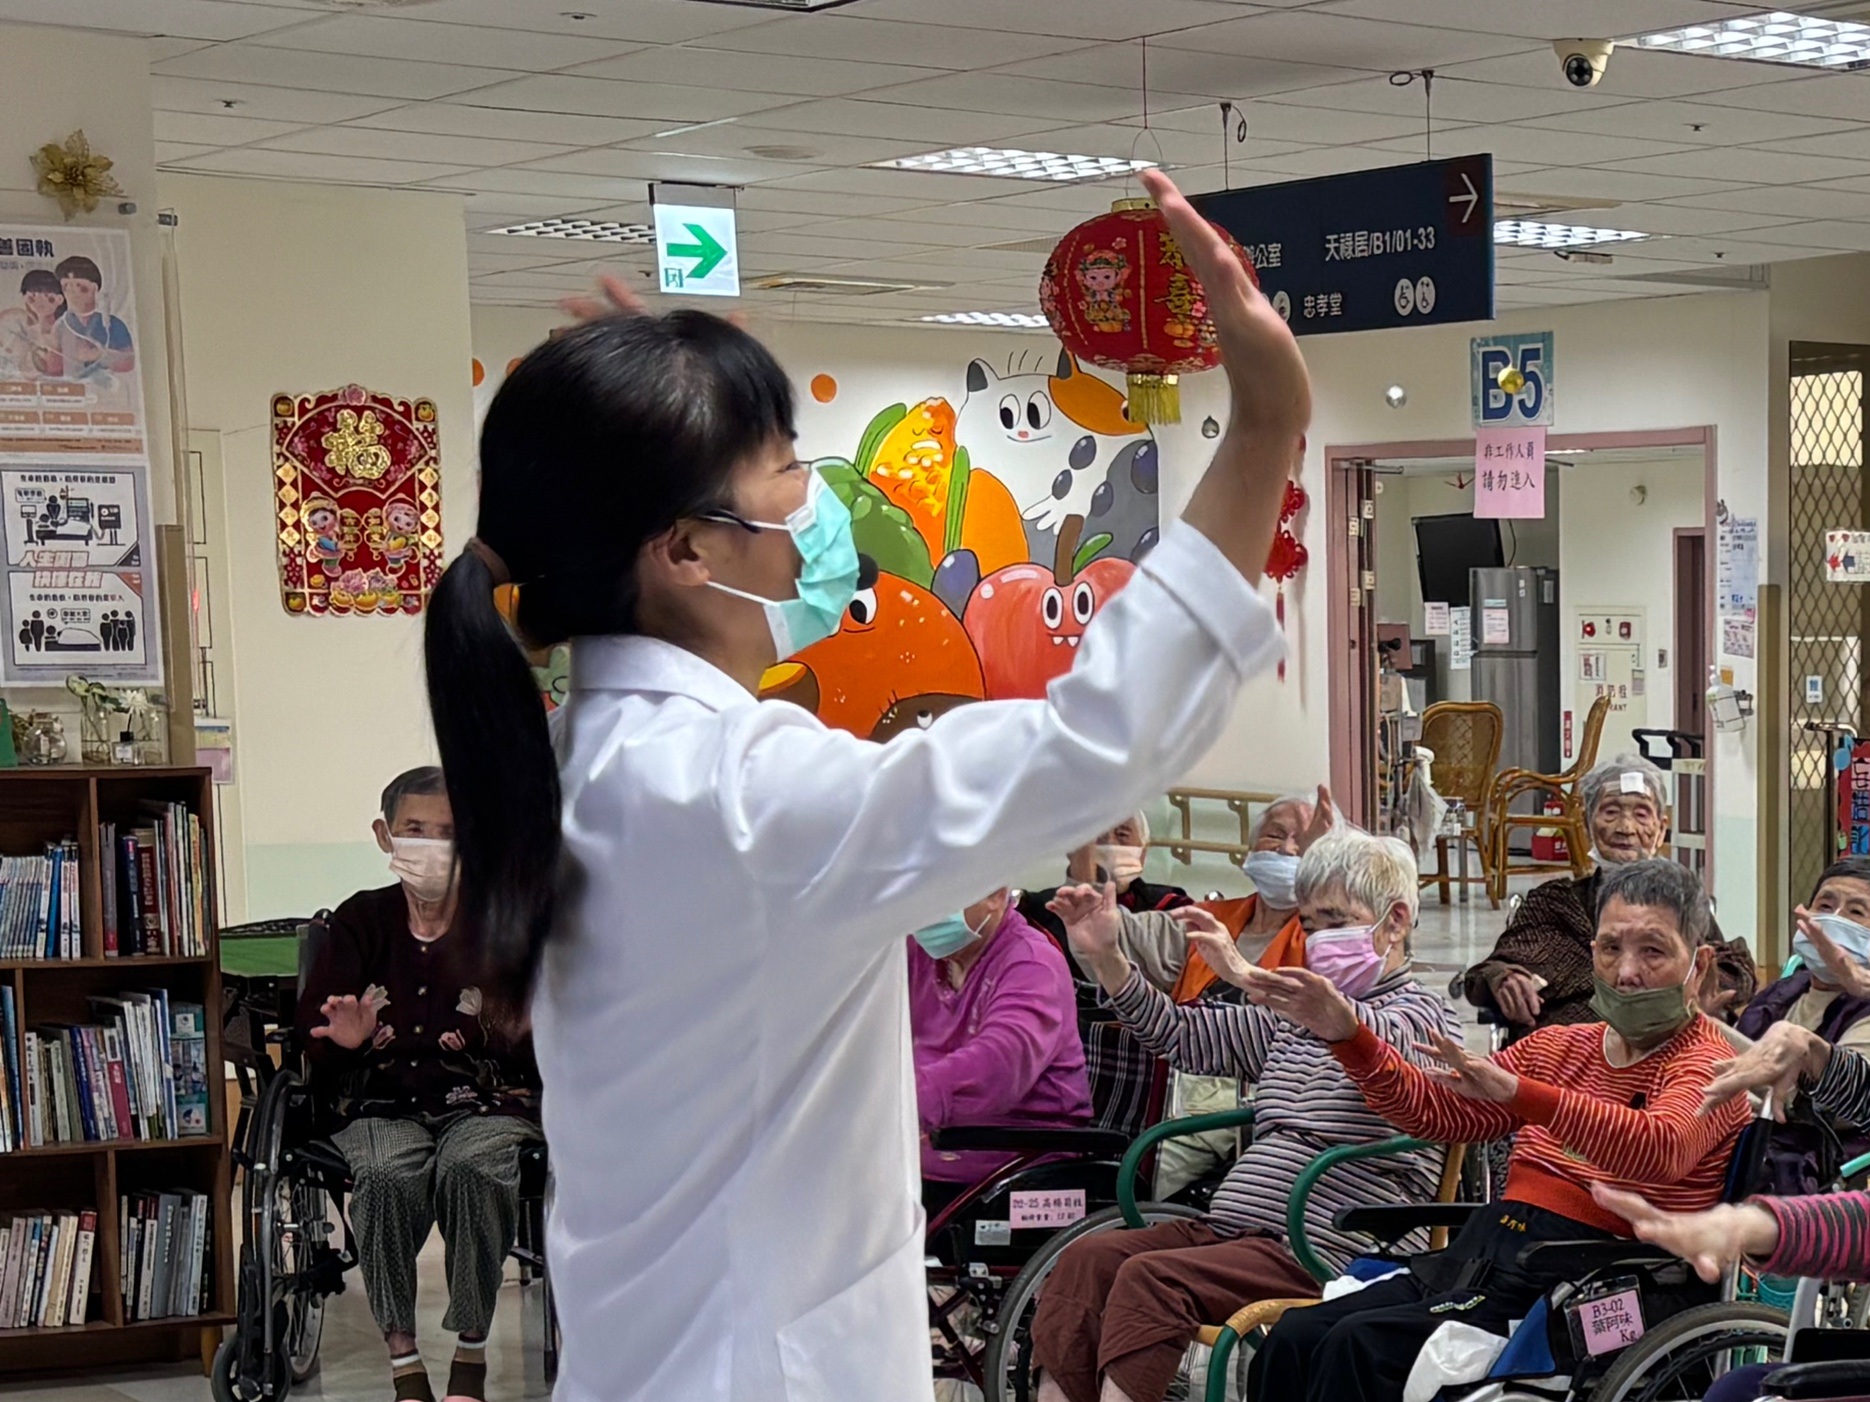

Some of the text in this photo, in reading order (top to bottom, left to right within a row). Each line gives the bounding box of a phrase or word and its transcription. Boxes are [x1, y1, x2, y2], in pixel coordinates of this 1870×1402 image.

[1304, 293, 1342, 318] 忠孝堂
[1480, 346, 1543, 421] B5
[321, 408, 392, 480] 福
[1483, 441, 1534, 460] 非工作人員
[1482, 469, 1536, 491] 請勿進入
[1609, 703, 1627, 711] RANT
[1592, 1299, 1624, 1318] B3-02
